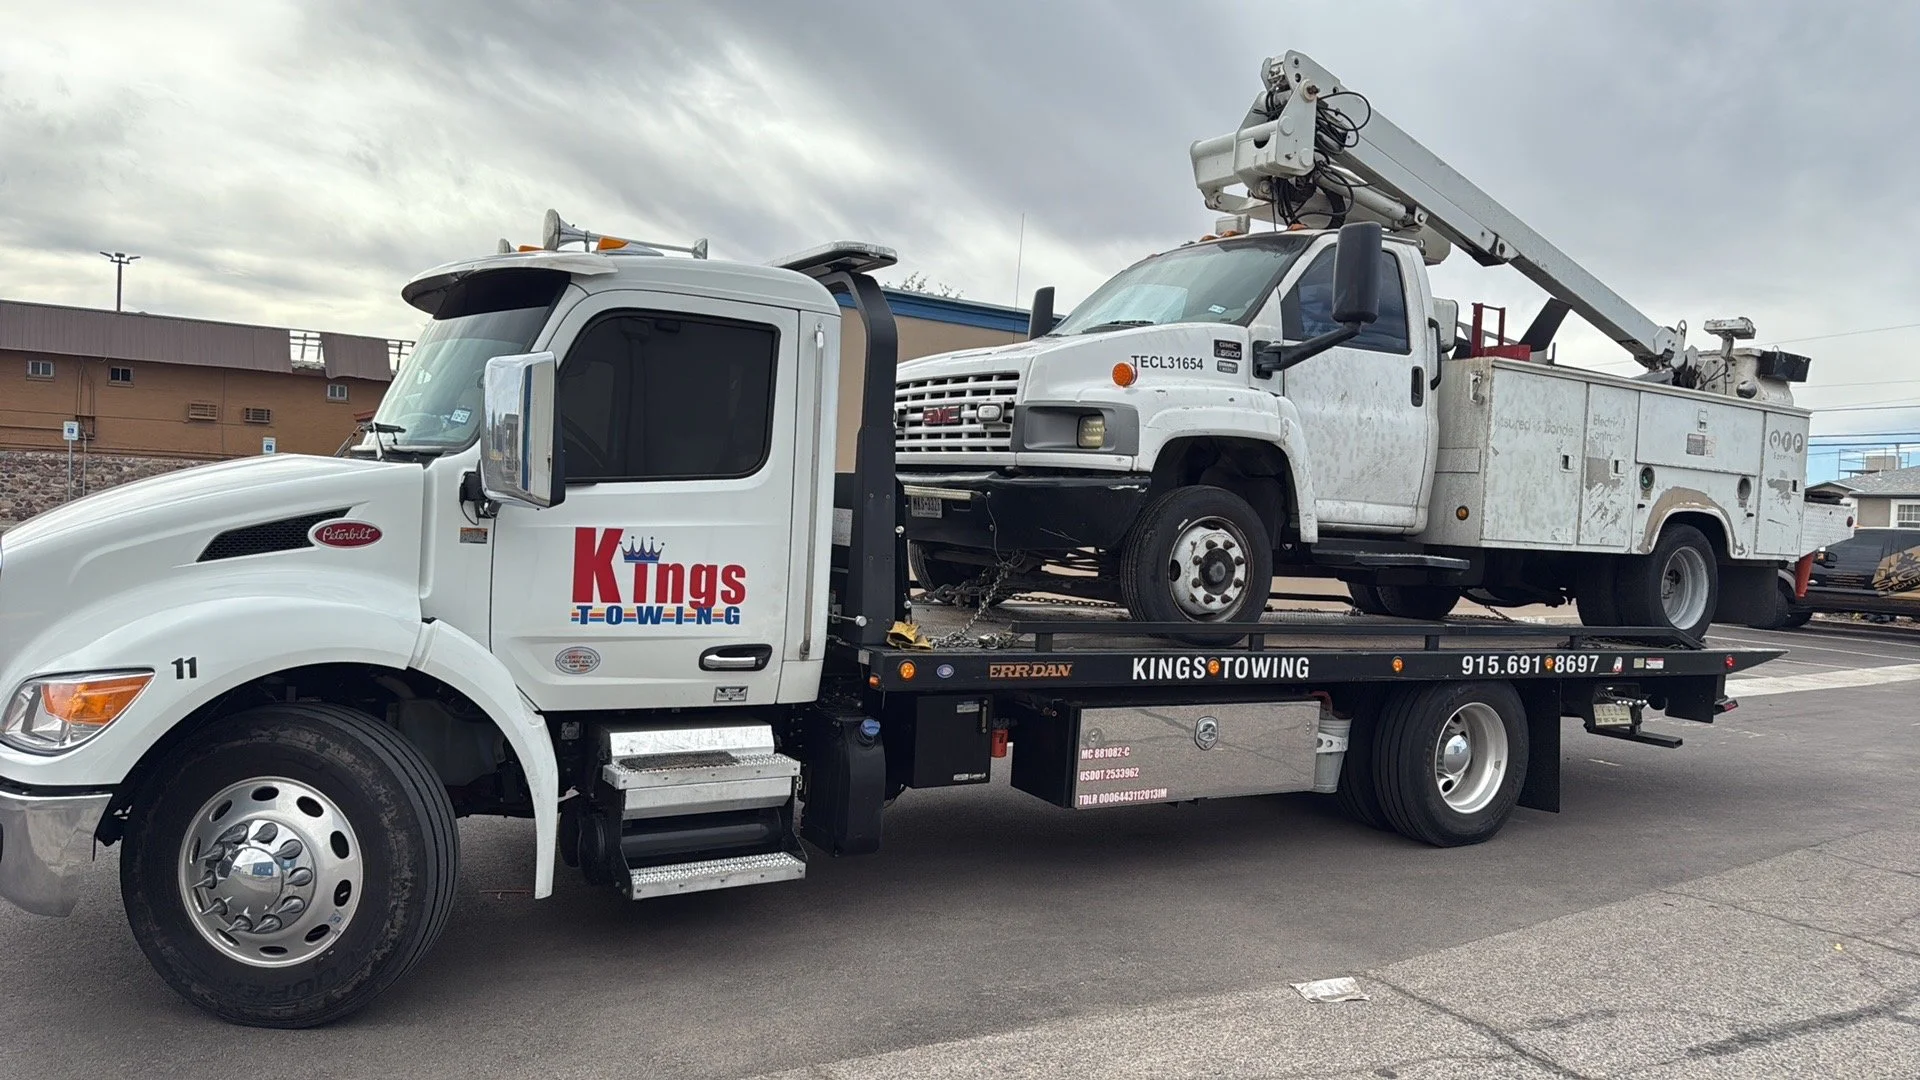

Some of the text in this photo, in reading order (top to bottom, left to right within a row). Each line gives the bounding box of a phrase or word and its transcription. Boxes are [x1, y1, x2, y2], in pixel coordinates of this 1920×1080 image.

[1219, 341, 1238, 350] GMC
[1131, 355, 1203, 370] TECL31654
[322, 526, 376, 541] Peterbilt
[572, 526, 746, 609] Kings
[576, 605, 740, 625] TOWING
[171, 656, 197, 680] 11
[1132, 656, 1309, 680] KINGS TOWING
[1462, 655, 1599, 675] 915.691 8697
[1081, 746, 1130, 760] MC 881082-C
[1080, 767, 1139, 781] USDOT 2533962
[1079, 794, 1098, 806] TDLR
